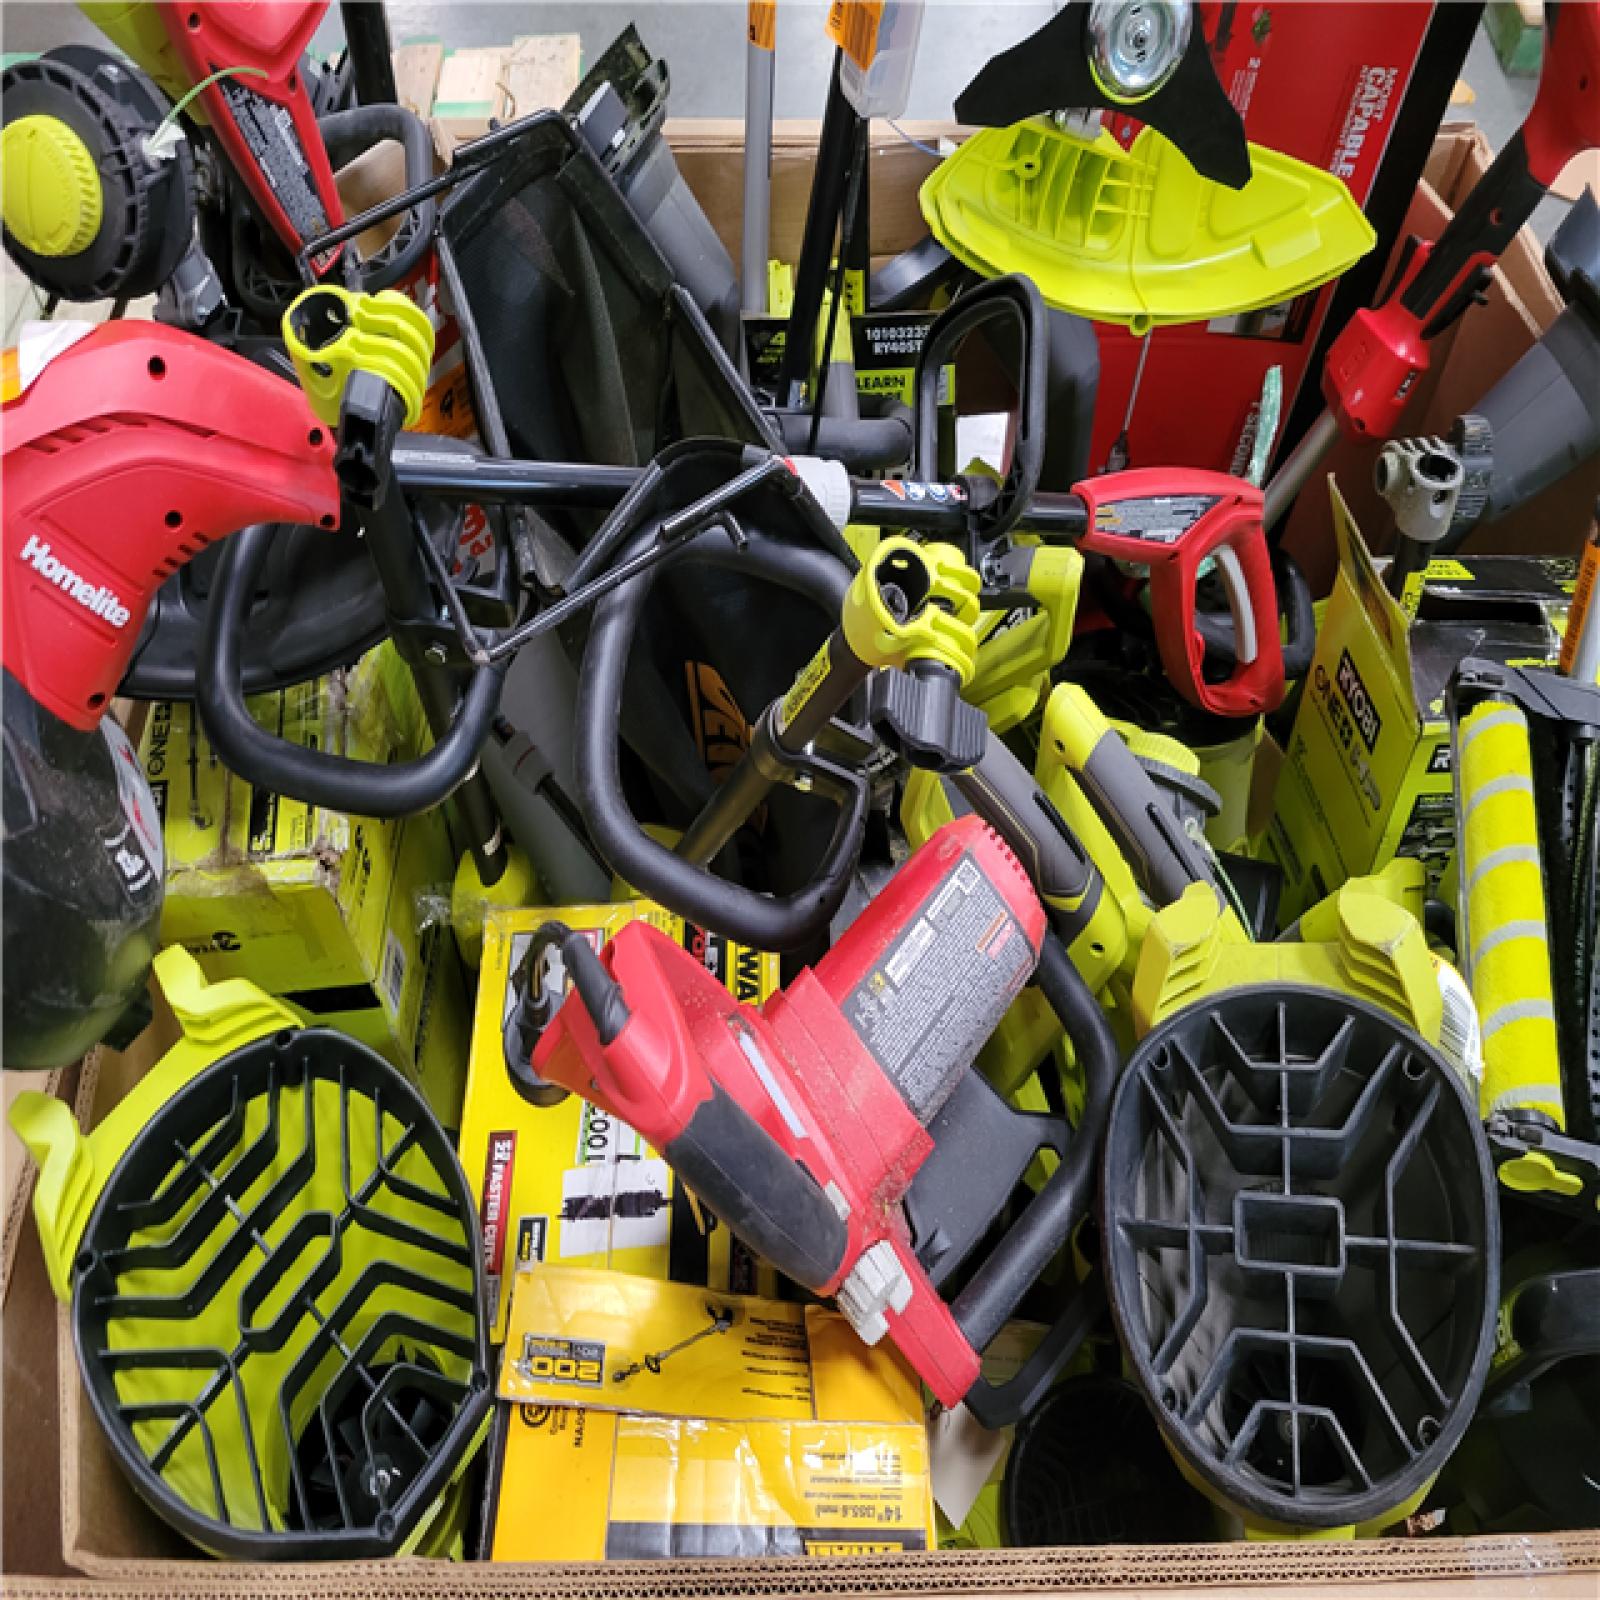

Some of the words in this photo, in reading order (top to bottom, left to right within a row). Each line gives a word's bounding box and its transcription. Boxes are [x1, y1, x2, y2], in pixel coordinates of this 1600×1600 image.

[1335, 66, 1387, 178] CAPABLE
[20, 534, 131, 628] Homelite
[530, 1356, 600, 1381] 200
